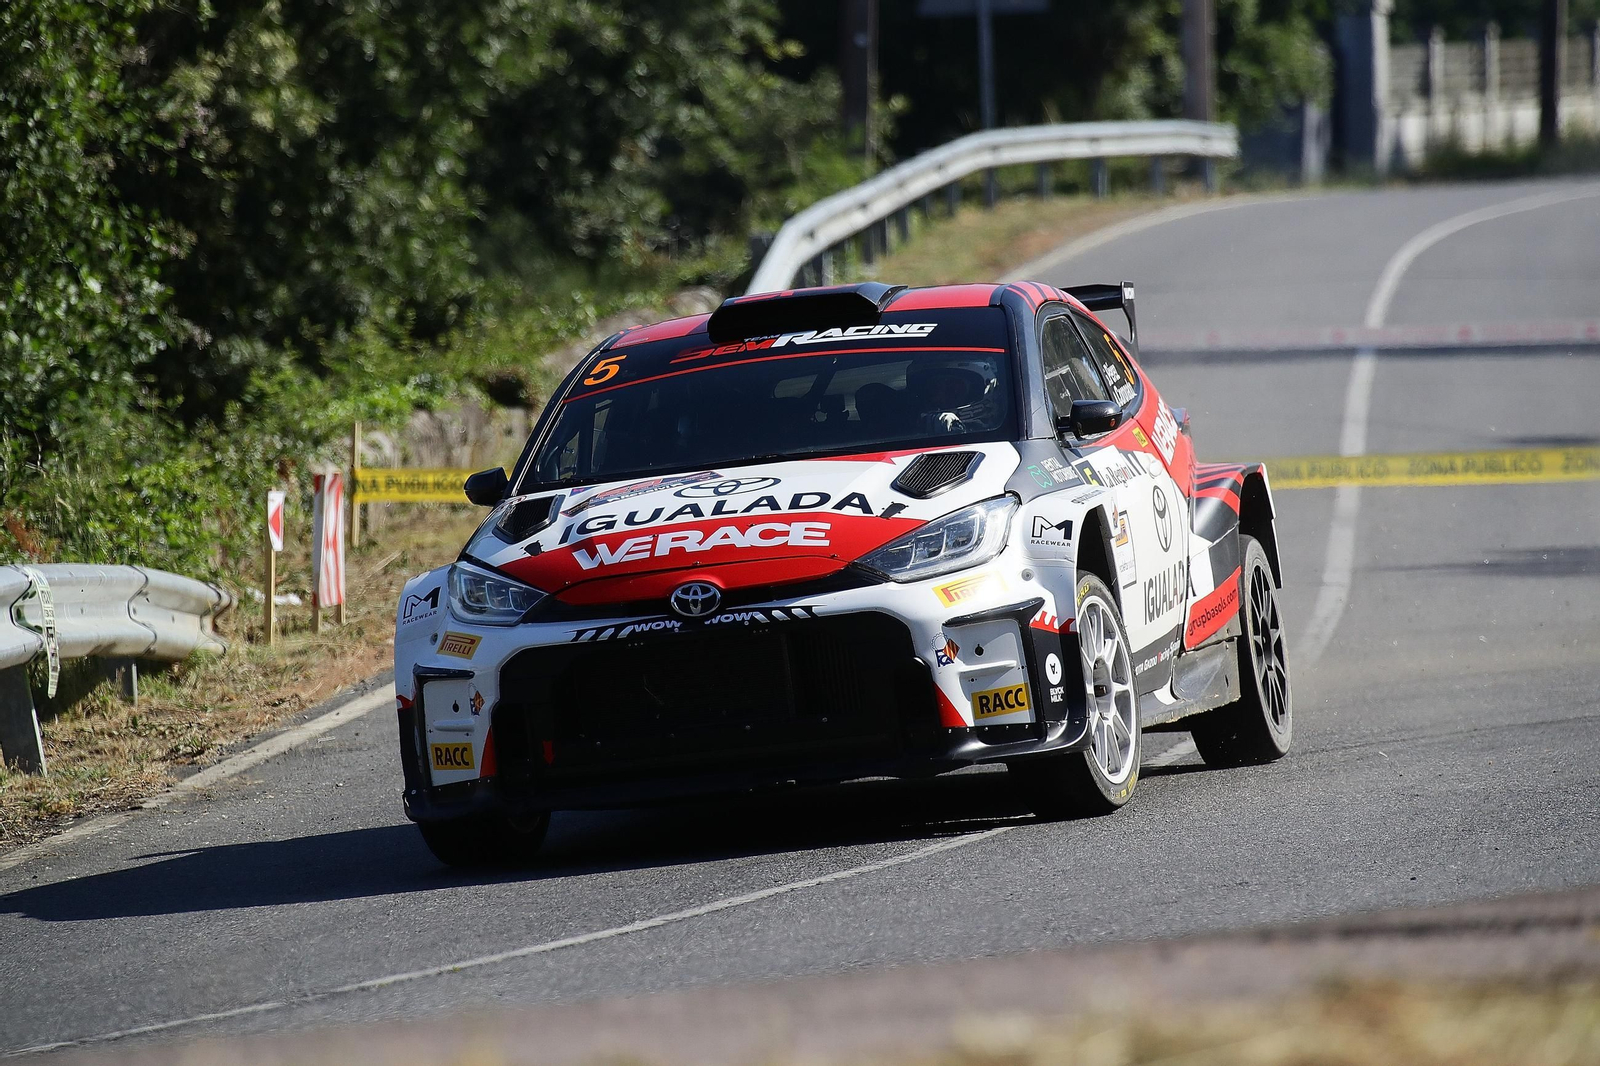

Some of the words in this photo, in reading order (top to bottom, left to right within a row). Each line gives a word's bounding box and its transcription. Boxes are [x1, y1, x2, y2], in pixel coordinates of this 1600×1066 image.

[743, 333, 780, 343] TEAM
[583, 354, 627, 386] 5
[558, 491, 874, 544] IGUALADA
[572, 521, 831, 571] WERACE
[1030, 539, 1071, 547] RACEWEAR
[1142, 555, 1197, 626] IGUALADA
[402, 610, 438, 626] RACEWEAR
[1187, 586, 1239, 637] grupbasols.com
[440, 634, 477, 656] PIRELLI
[978, 687, 1027, 714] RACC
[434, 746, 470, 767] RACC
